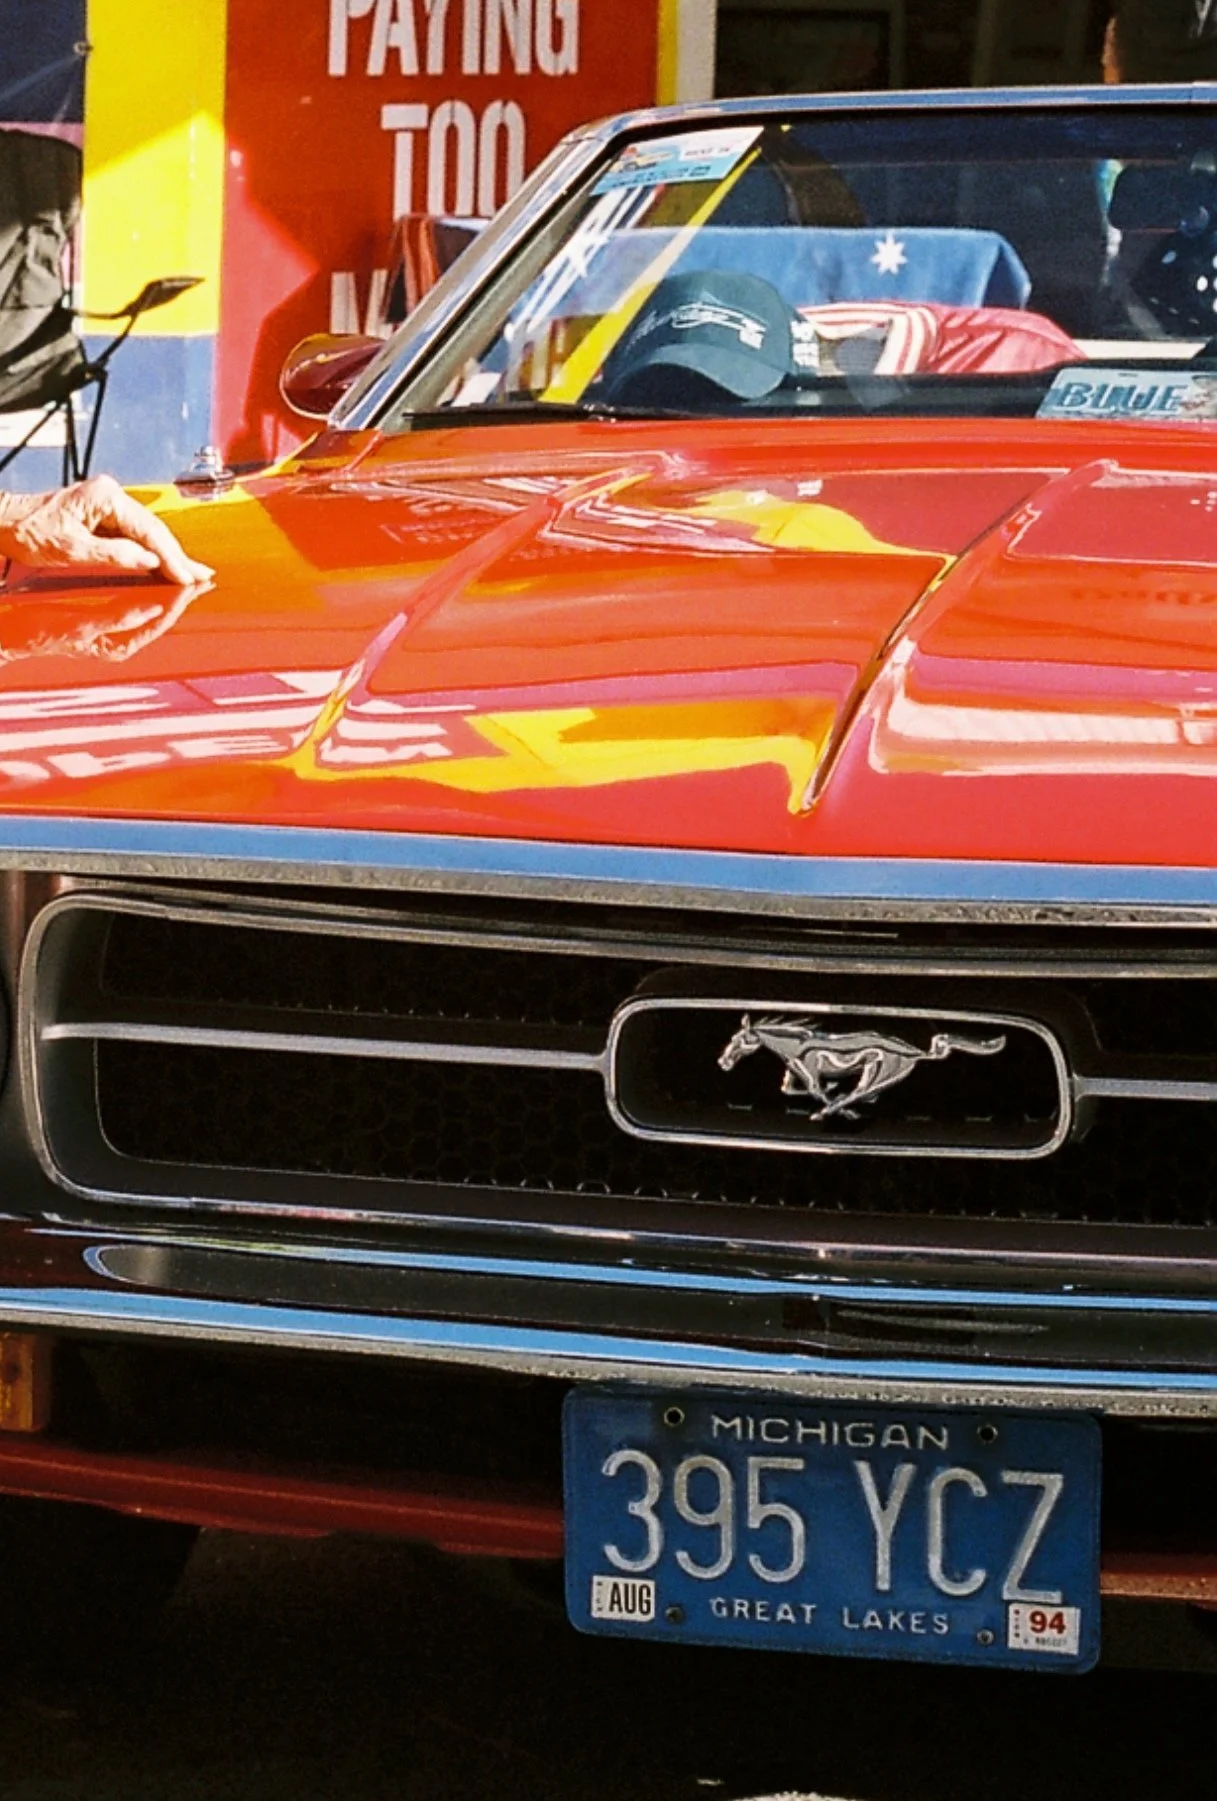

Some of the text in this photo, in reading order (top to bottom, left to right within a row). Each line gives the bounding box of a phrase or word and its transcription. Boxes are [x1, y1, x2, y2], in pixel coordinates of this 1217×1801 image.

[381, 100, 525, 220] TOO
[710, 1413, 949, 1451] MICHIGAN
[601, 1448, 1065, 1603] 395 YCZ
[609, 1581, 651, 1616] AUG
[710, 1596, 950, 1636] GREAT LAKES
[1029, 1610, 1066, 1634] 94
